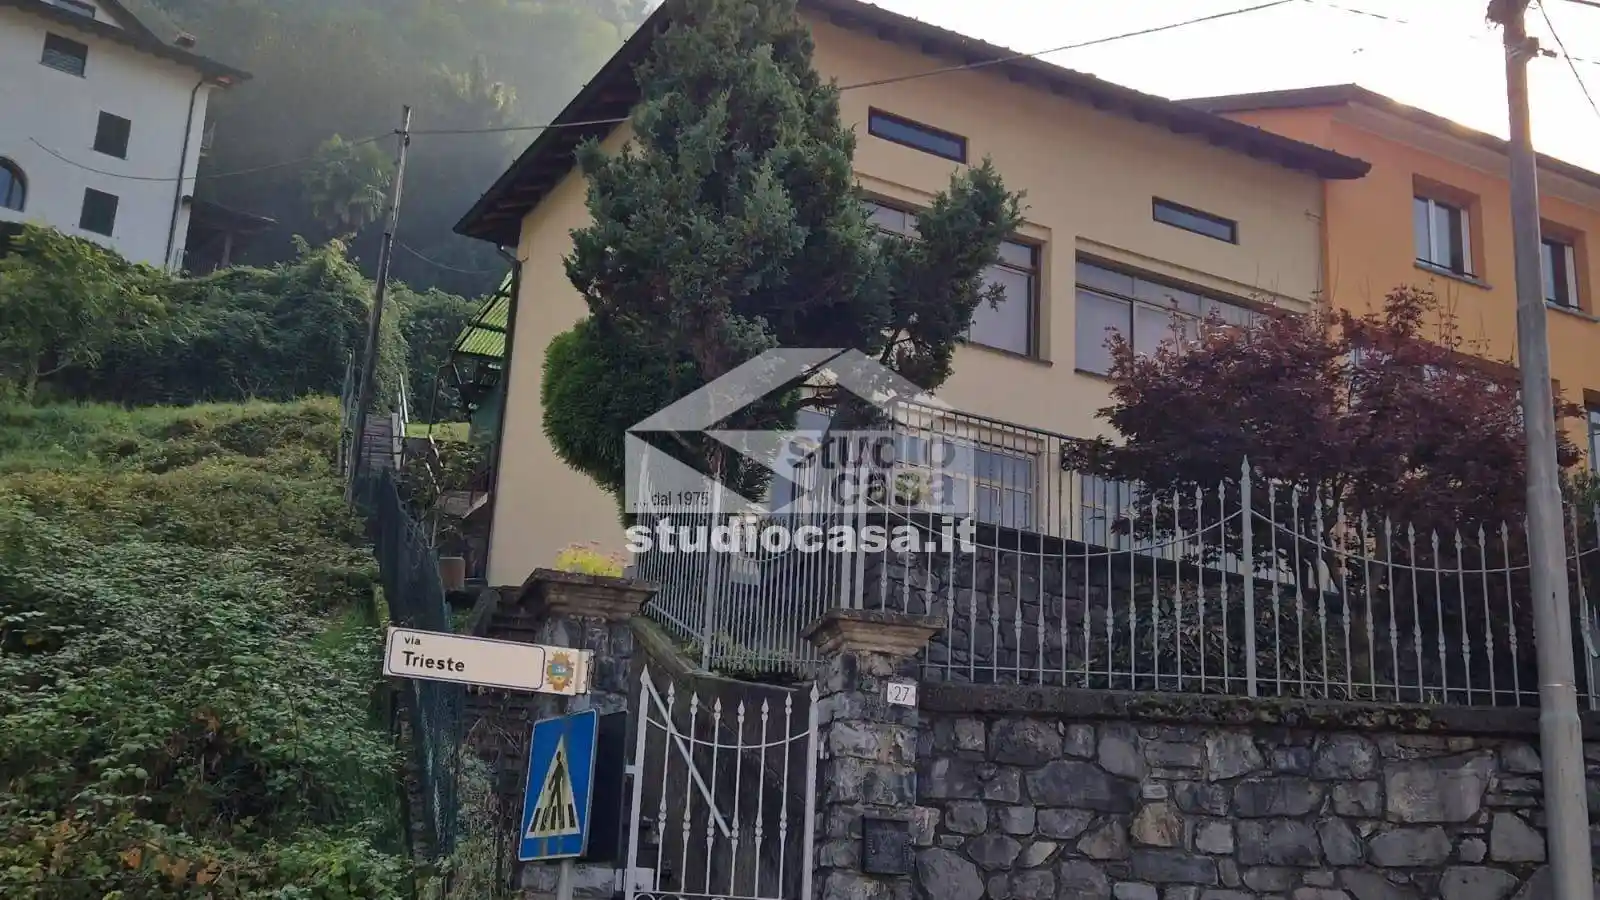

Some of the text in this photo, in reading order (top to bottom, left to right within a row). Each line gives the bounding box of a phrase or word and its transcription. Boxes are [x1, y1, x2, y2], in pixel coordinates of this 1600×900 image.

[404, 637, 421, 646] via
[402, 651, 465, 672] Trieste
[894, 685, 909, 702] 27
